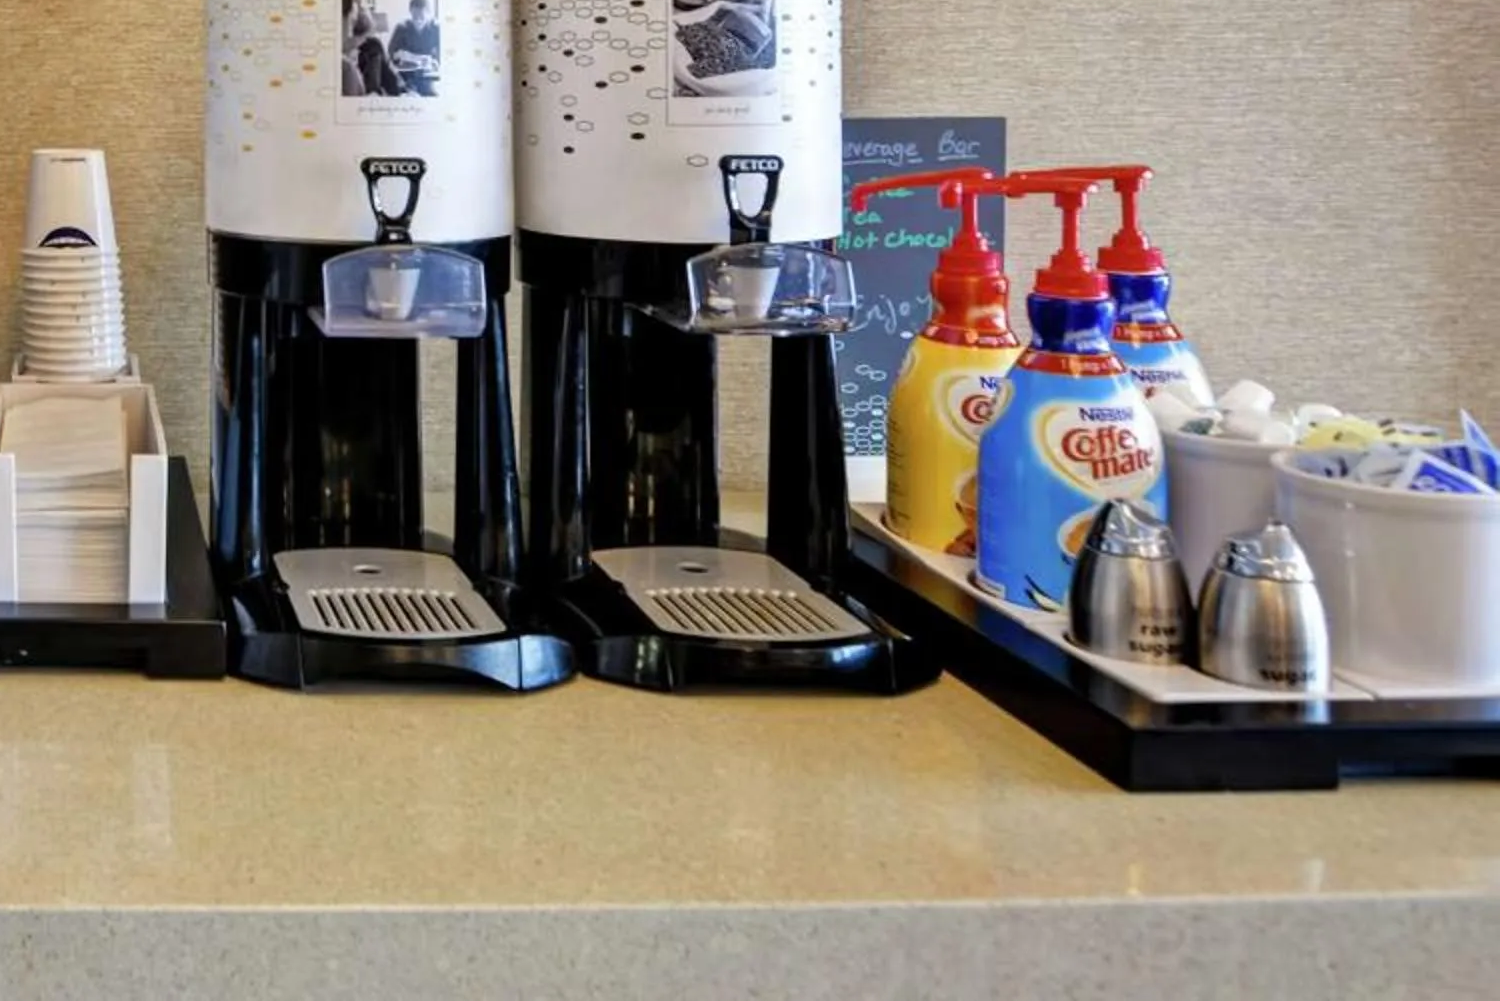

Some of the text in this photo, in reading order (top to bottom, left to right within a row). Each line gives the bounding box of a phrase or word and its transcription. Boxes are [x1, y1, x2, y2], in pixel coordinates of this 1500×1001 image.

[843, 128, 981, 167] everage Bar
[368, 162, 421, 174] FETCO
[730, 158, 780, 170] FETCO
[838, 230, 879, 249] Hot
[1140, 624, 1177, 637] raw
